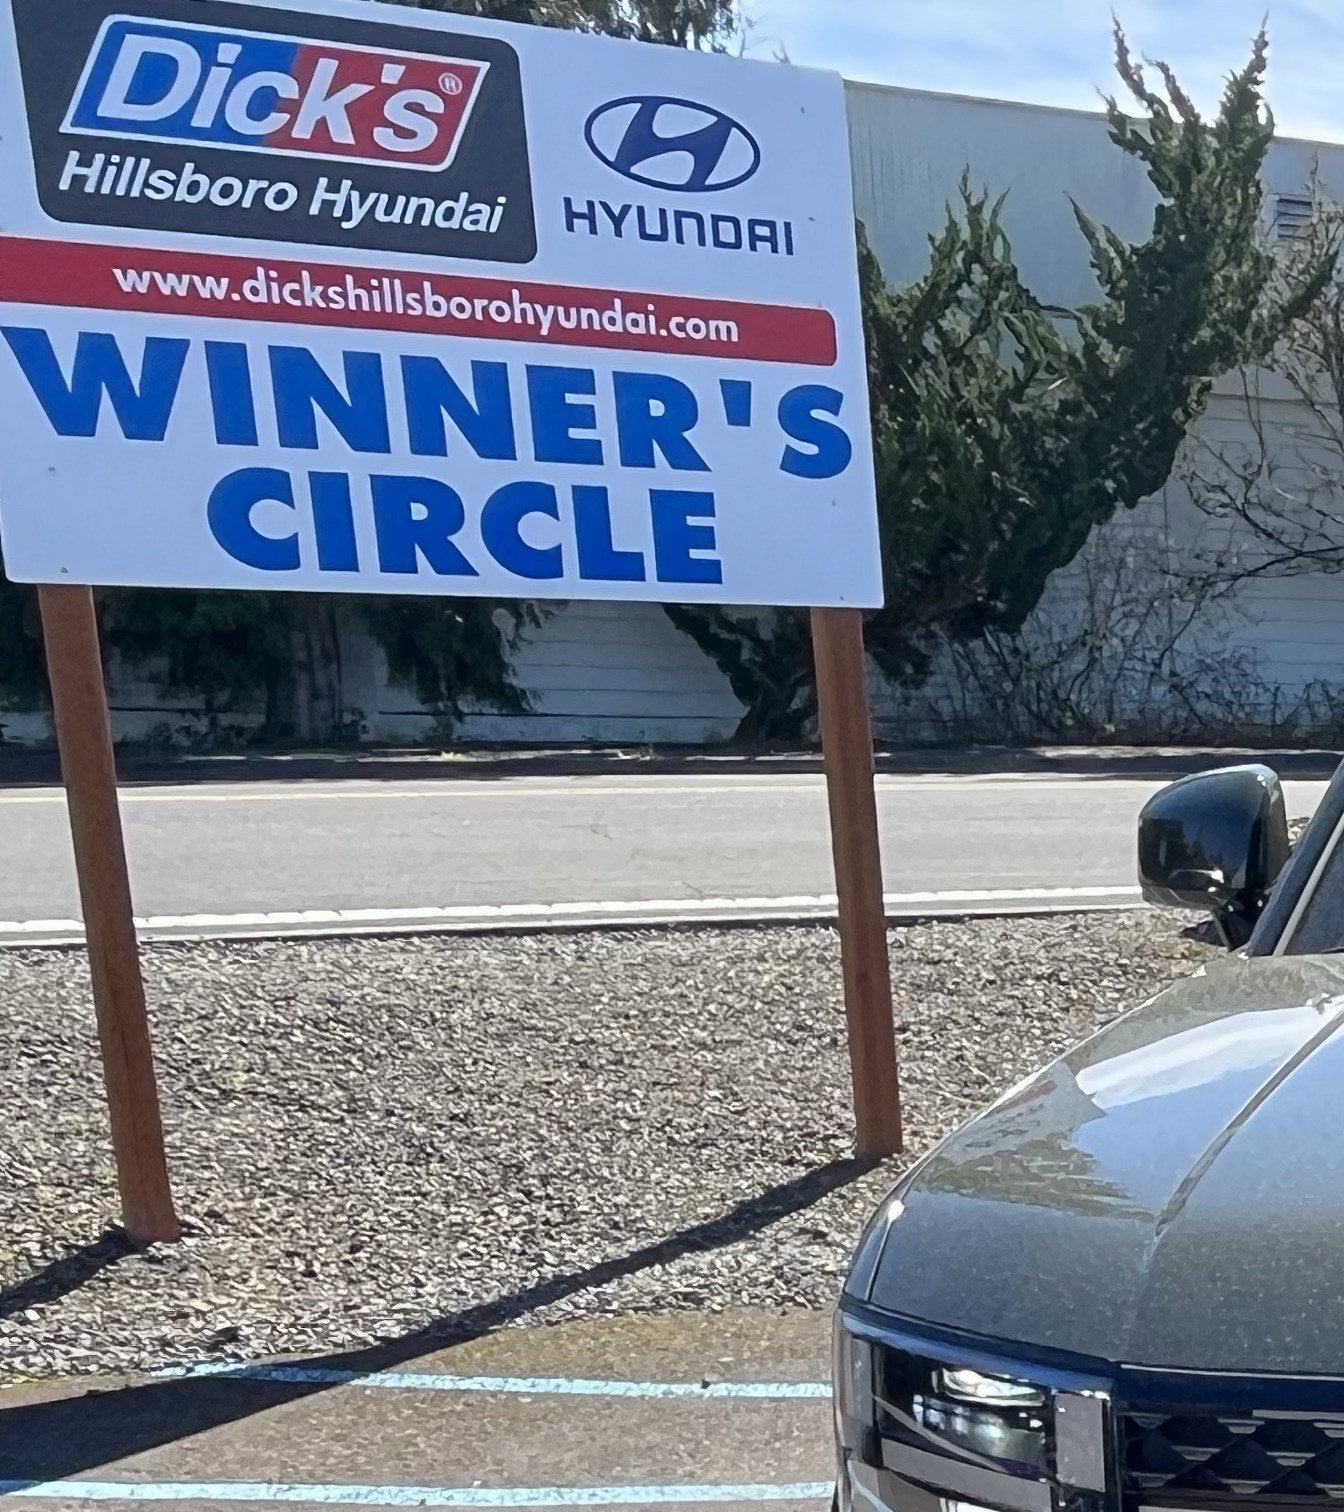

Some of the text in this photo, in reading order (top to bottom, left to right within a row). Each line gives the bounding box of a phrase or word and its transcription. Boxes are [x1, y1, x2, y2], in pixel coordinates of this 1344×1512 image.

[93, 34, 450, 154] Dick's
[58, 150, 507, 235] Hillsboro Hyundai
[565, 197, 794, 256] HYUNDAI
[113, 263, 740, 344] www.dickshillsborohyundai.com
[3, 326, 852, 480] WINNER'S
[206, 466, 723, 585] CIRCLE
